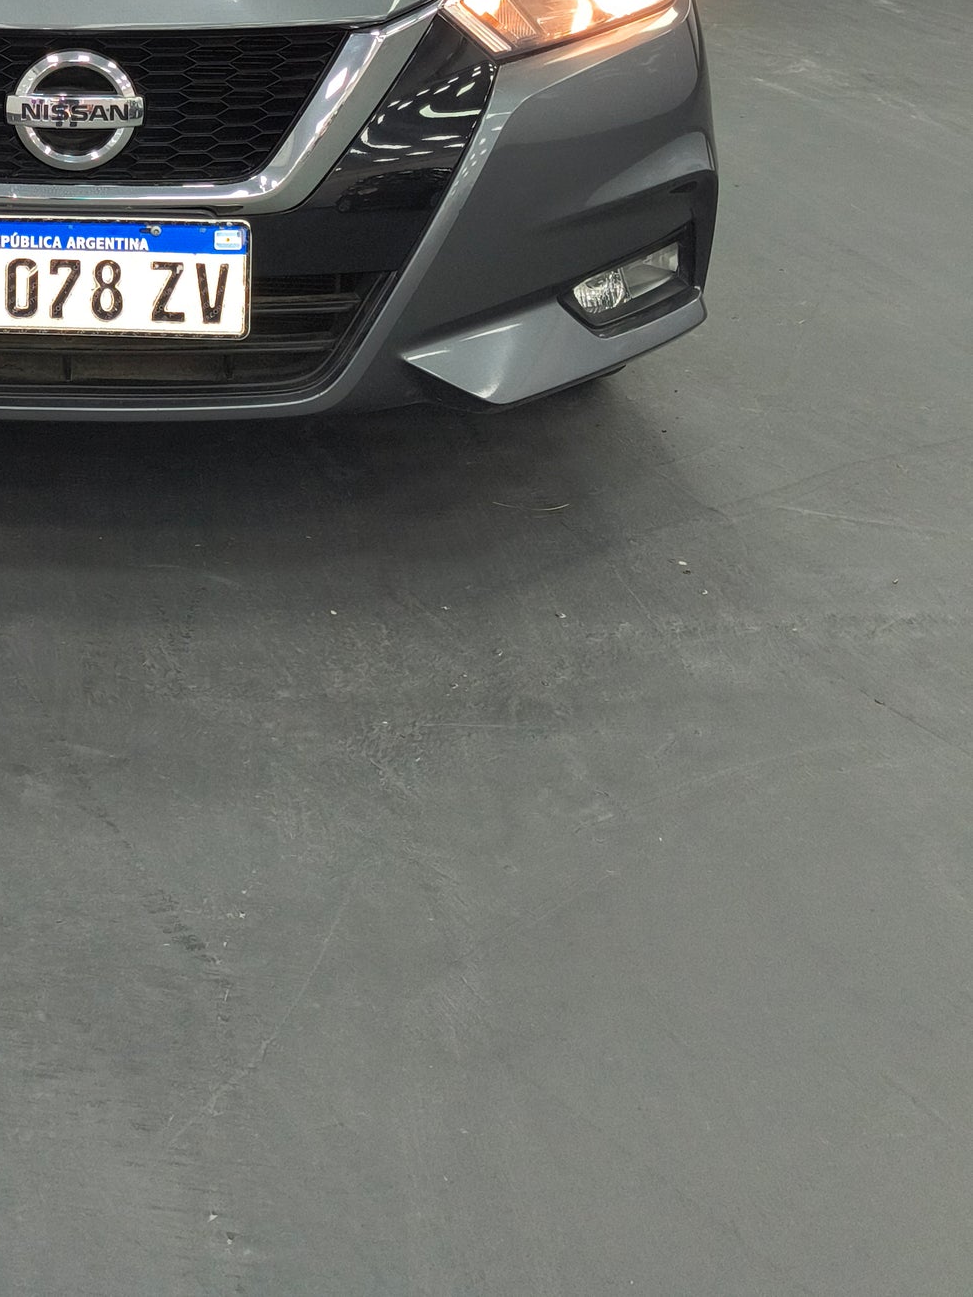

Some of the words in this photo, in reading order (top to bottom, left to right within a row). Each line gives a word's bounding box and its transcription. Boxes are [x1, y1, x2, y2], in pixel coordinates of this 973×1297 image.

[21, 103, 128, 122] NISSAN
[65, 236, 149, 251] ARGENTINA
[4, 258, 124, 322] 078
[150, 261, 229, 324] ZV
